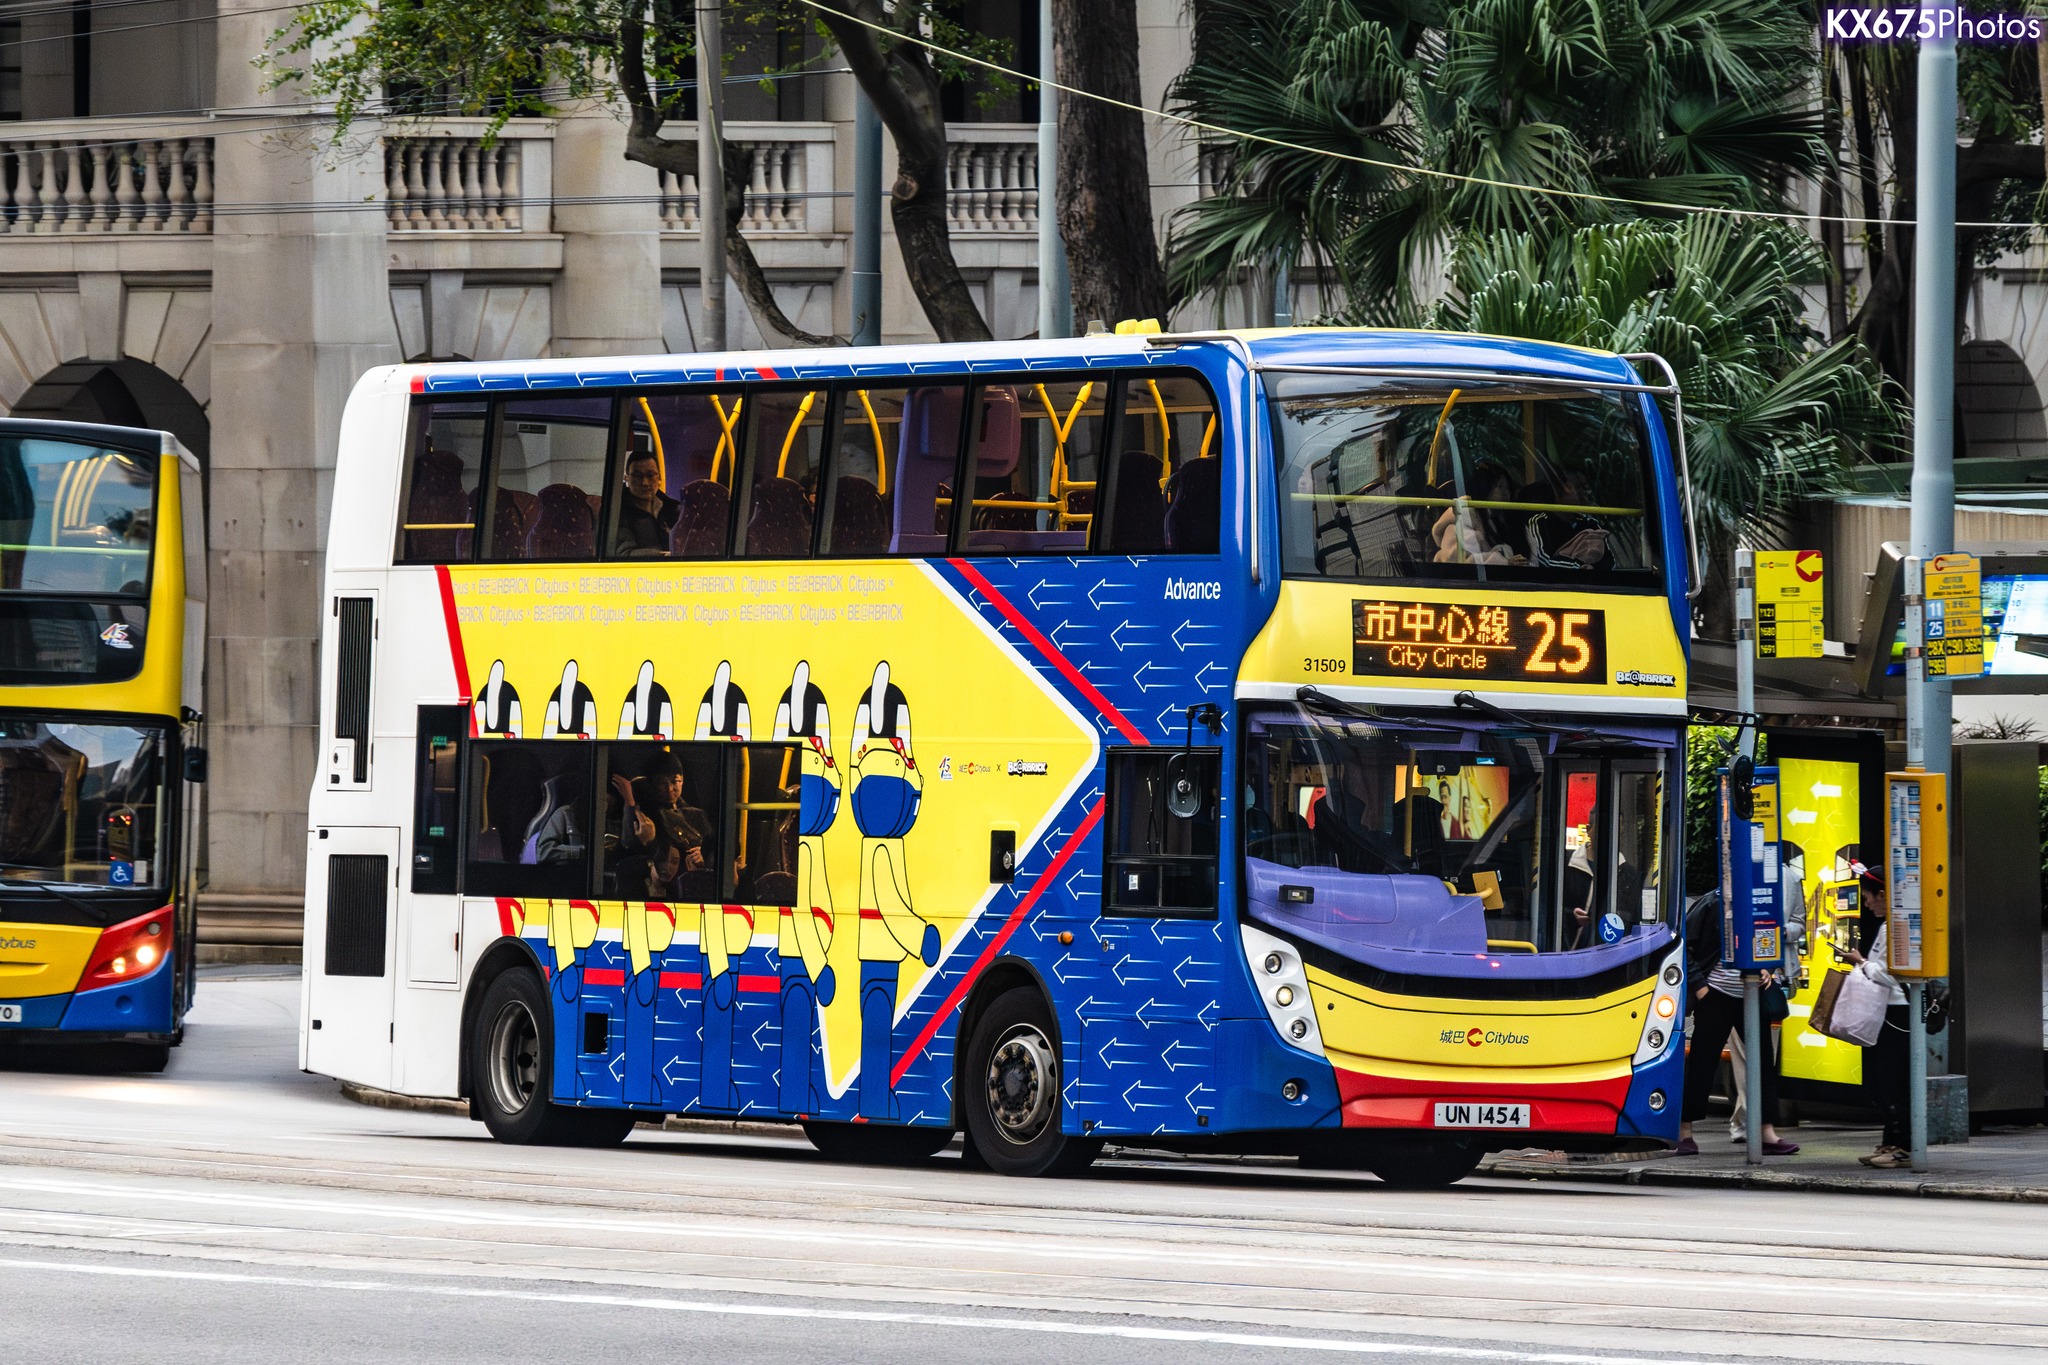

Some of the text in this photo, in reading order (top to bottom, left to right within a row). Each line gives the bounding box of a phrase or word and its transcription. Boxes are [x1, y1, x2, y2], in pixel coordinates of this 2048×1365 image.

[534, 578, 569, 598] Citybus
[636, 577, 672, 598] Citybus
[741, 576, 777, 597] Citybus
[849, 575, 885, 597] Citybus
[1163, 577, 1221, 600] Advance
[490, 606, 523, 626] Citybus
[590, 605, 625, 626] Citybus
[694, 605, 729, 626] Citybus
[800, 604, 836, 626] Citybus
[1929, 602, 1942, 617] 11
[1363, 601, 1510, 645] 市中心線
[1929, 621, 1943, 636] 25
[1524, 611, 1594, 674] 25
[1303, 658, 1346, 673] 31509
[1388, 645, 1488, 671] City Circle
[1439, 1030, 1465, 1044] 城巴
[1485, 1031, 1530, 1045] Citybus
[1445, 1105, 1520, 1125] UN 1454
